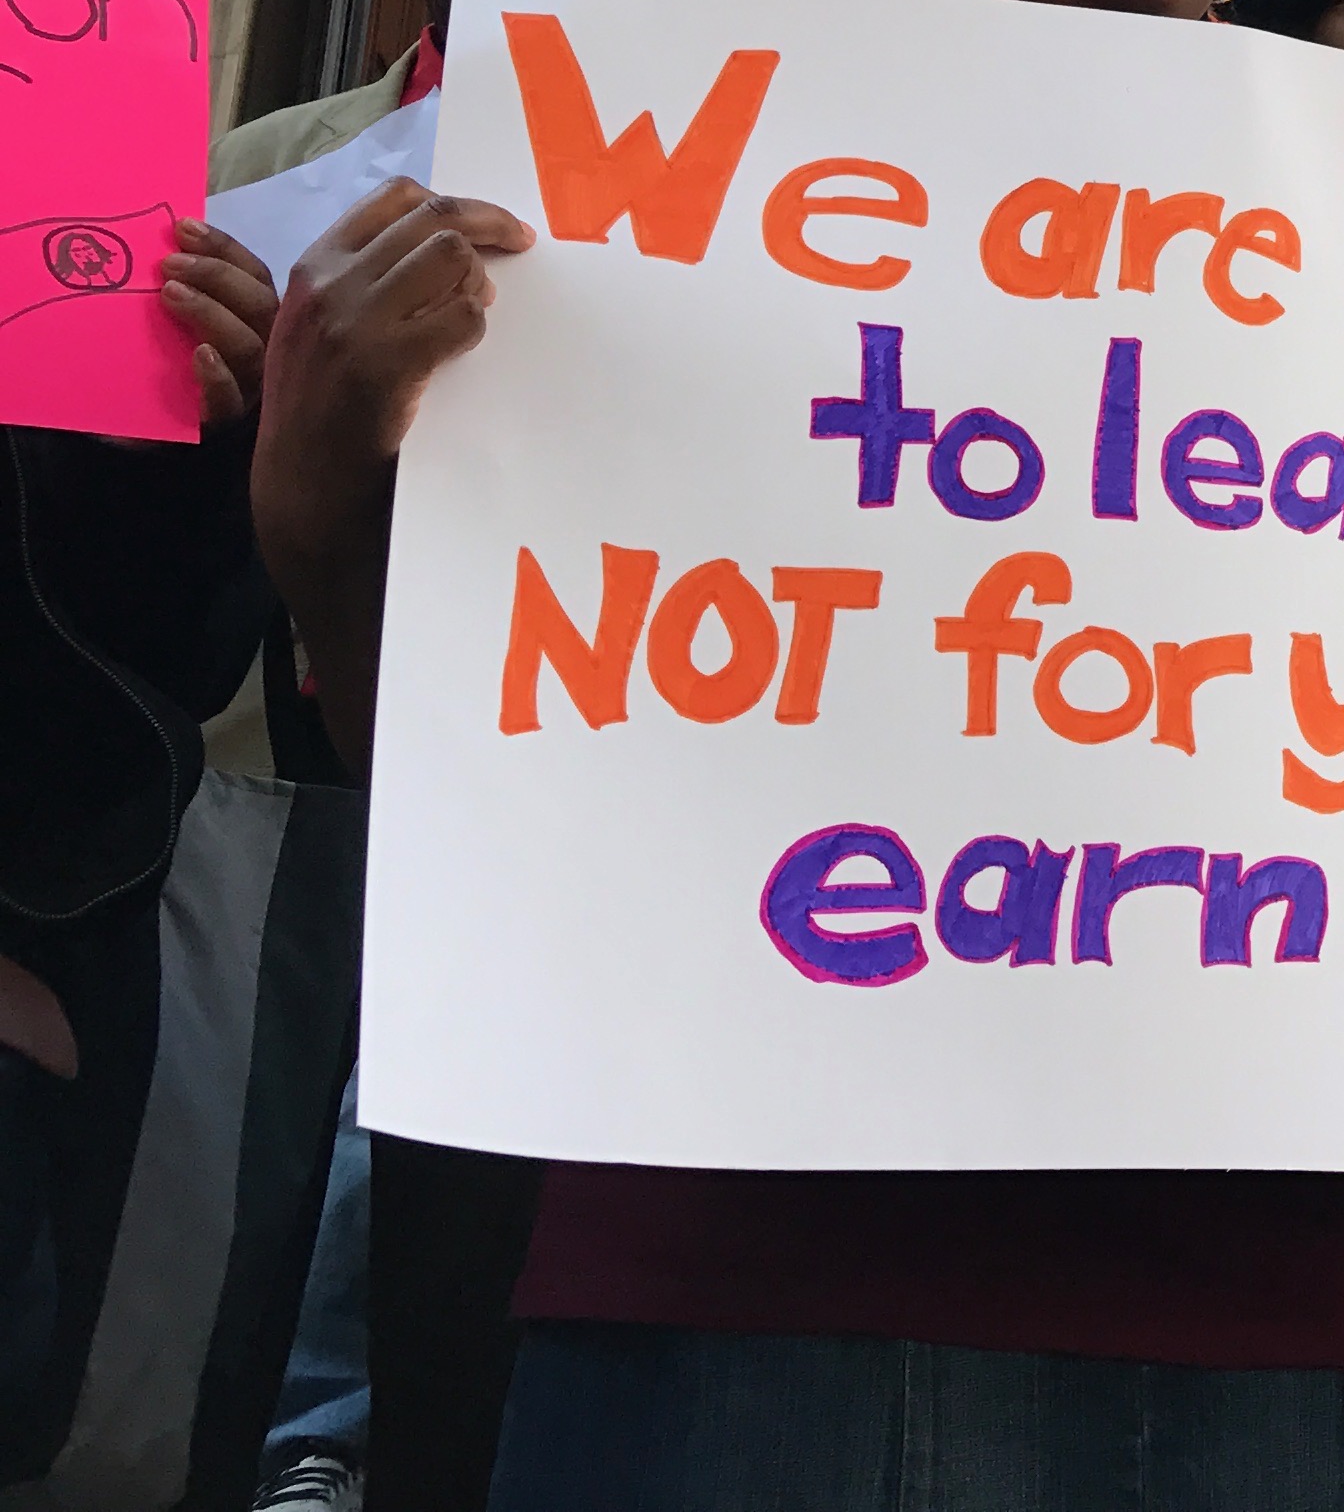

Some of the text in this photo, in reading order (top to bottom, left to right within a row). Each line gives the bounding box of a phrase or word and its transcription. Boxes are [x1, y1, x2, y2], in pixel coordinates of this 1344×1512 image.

[502, 13, 929, 291] We
[980, 177, 1301, 326] are
[810, 322, 1046, 522] to
[499, 543, 882, 736] NOT
[934, 551, 1252, 756] for
[759, 822, 1329, 988] earn
